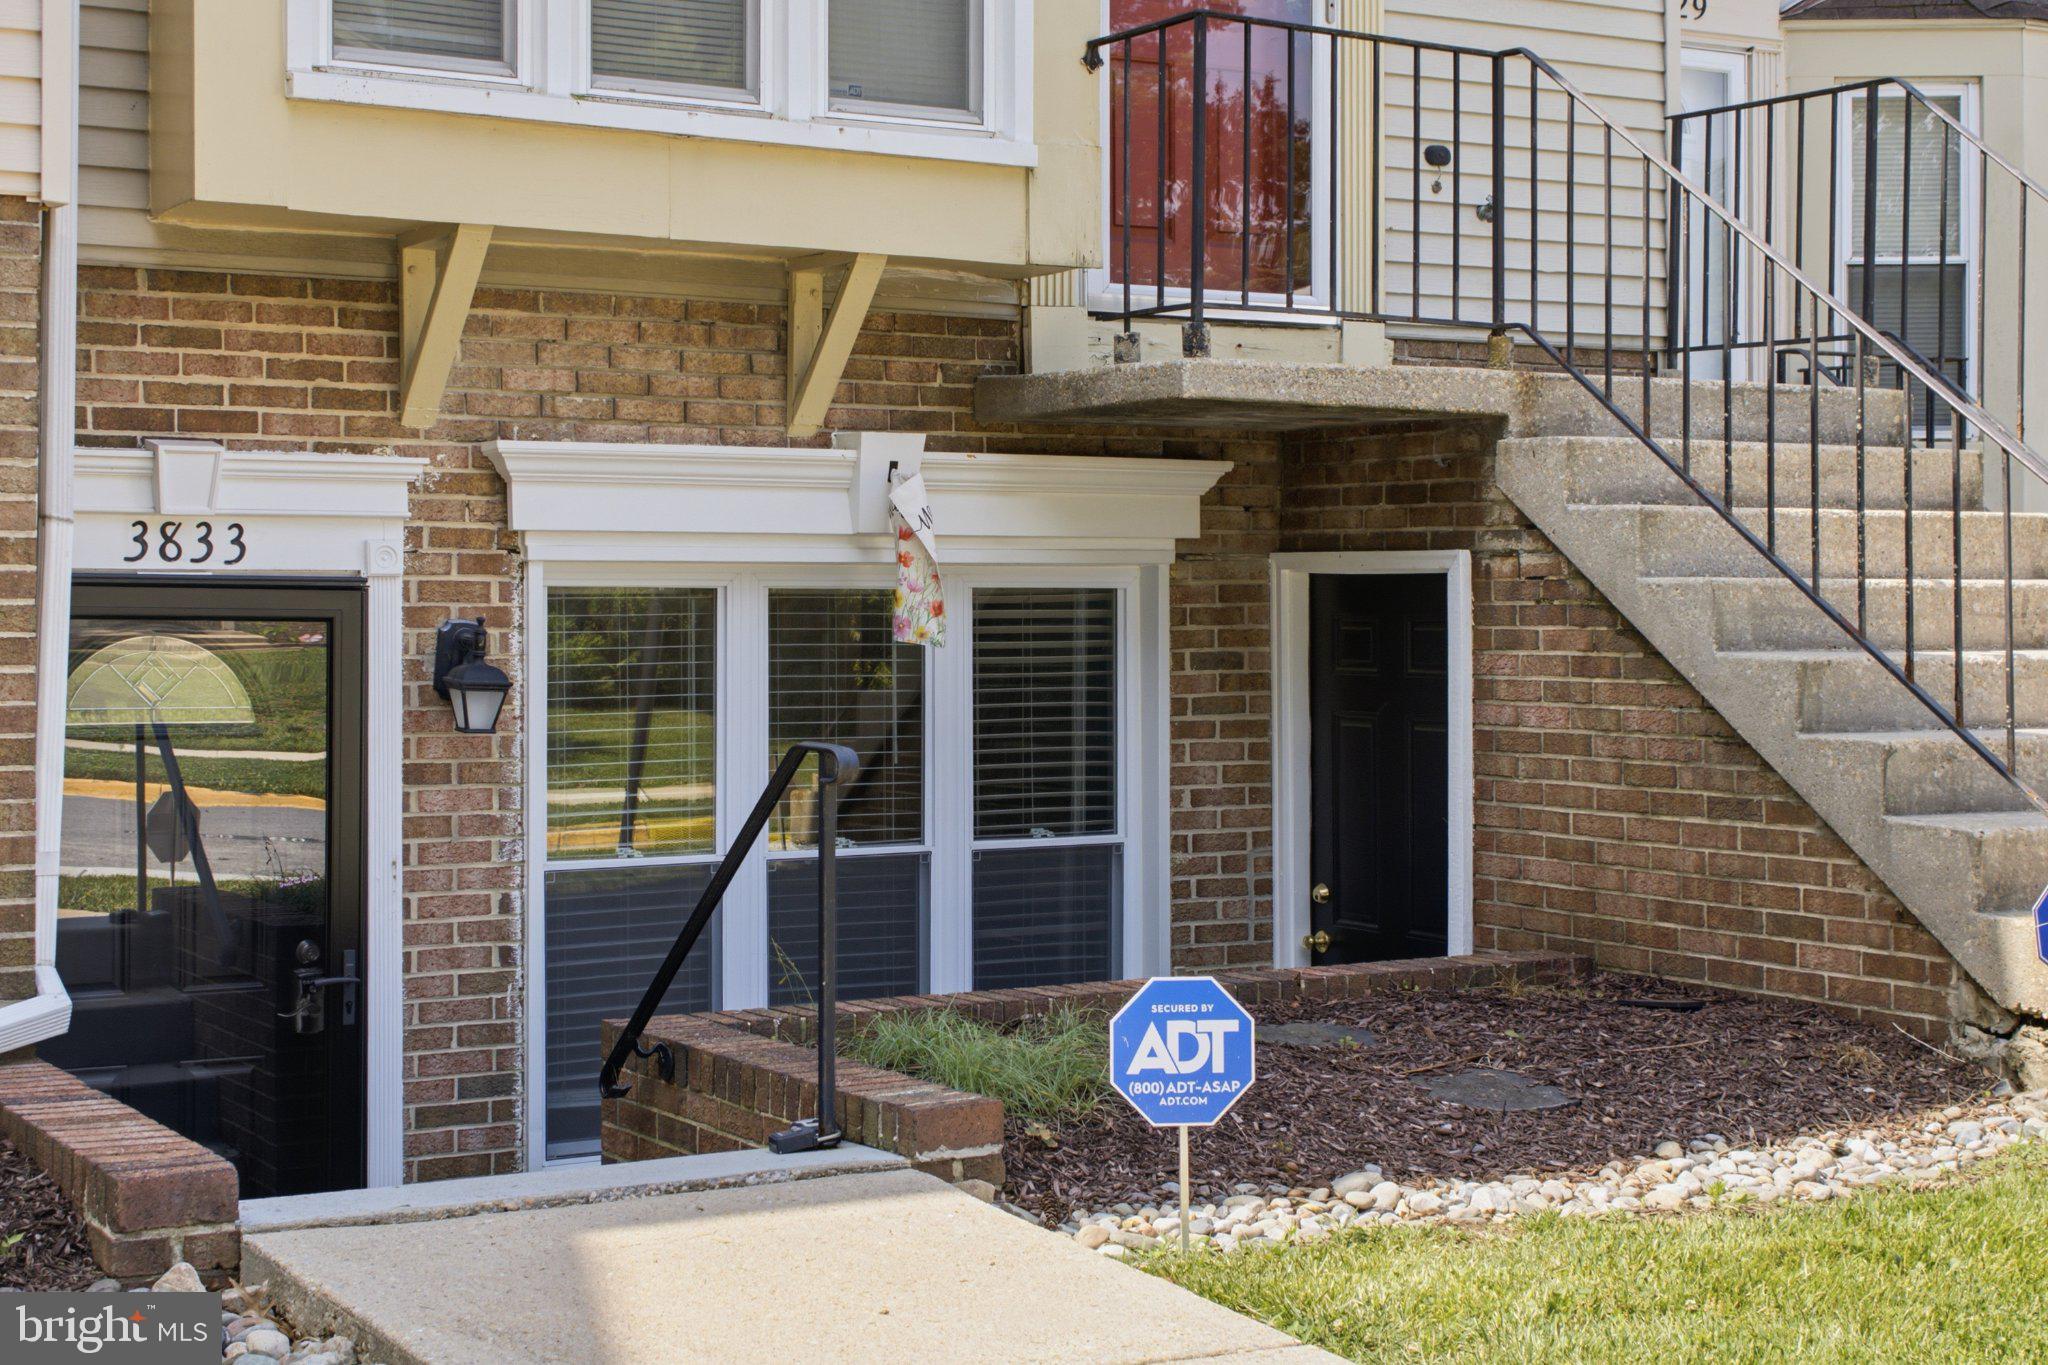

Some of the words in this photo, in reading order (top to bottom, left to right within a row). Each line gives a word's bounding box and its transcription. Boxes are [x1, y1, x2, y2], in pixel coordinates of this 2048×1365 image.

[123, 520, 247, 565] 3833
[1151, 1004, 1198, 1013] SECURED
[1201, 1004, 1214, 1012] BY
[1126, 1019, 1239, 1075] ADT
[1128, 1081, 1164, 1096] (800)
[1166, 1080, 1241, 1094] ADT-ASAP
[1159, 1096, 1208, 1106] ADT.COM
